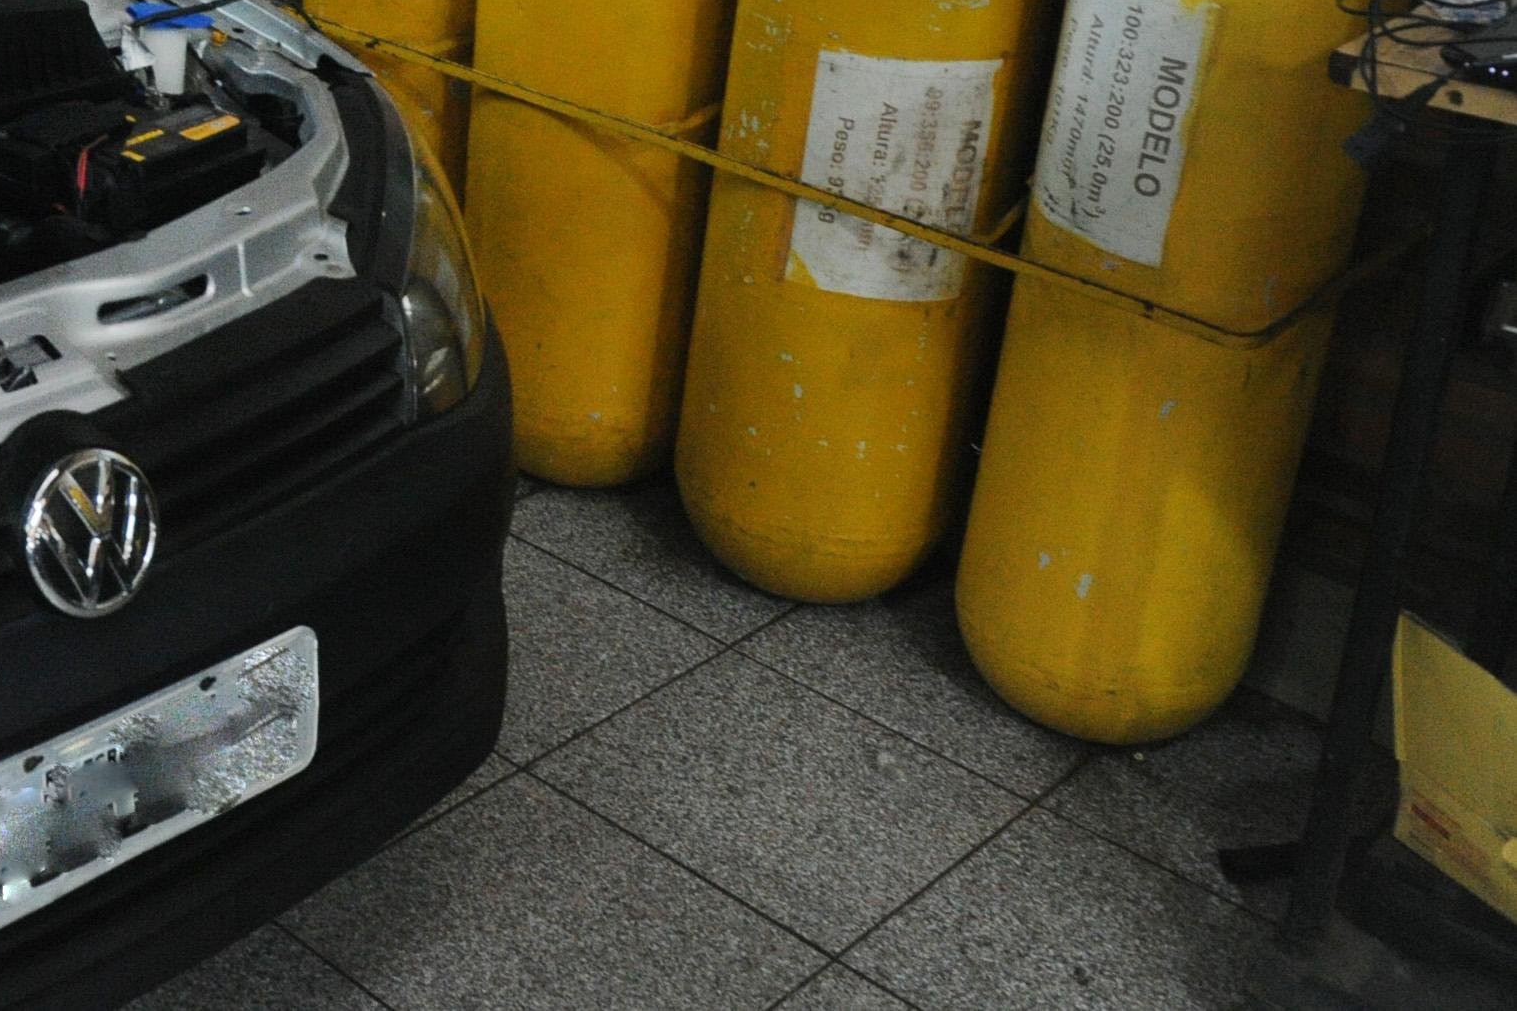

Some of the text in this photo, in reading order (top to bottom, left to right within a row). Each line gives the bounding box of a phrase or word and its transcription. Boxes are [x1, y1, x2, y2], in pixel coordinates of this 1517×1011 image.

[1105, 5, 1143, 130] 100:323:200
[832, 115, 855, 169] Peso:
[873, 101, 898, 167] Altura:
[1134, 56, 1187, 198] MODELO
